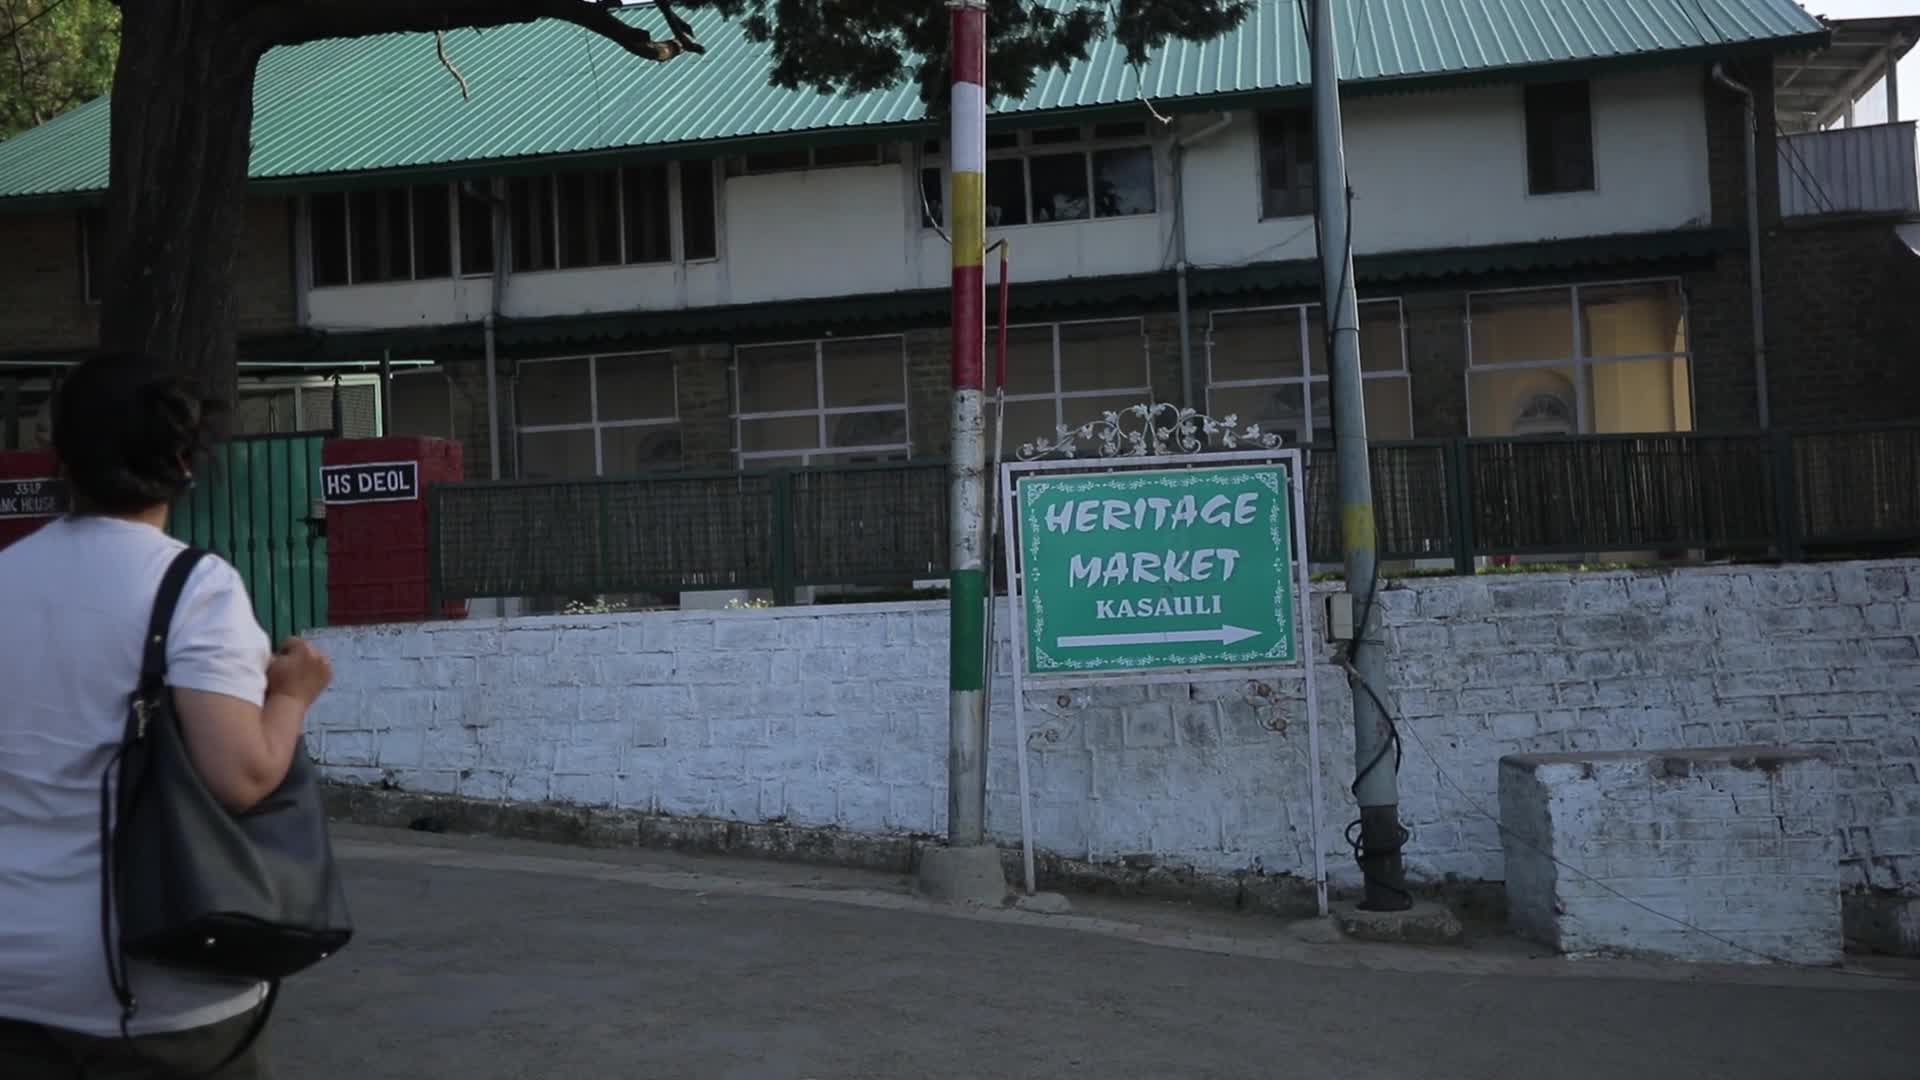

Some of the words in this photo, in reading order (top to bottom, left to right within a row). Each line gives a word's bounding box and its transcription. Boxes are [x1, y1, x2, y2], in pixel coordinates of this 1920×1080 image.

[327, 474, 351, 495] HS
[358, 470, 410, 493] DEOL
[1044, 492, 1259, 535] HERITAGE
[1069, 548, 1240, 589] MARKET
[1096, 595, 1222, 620] KASAULI
